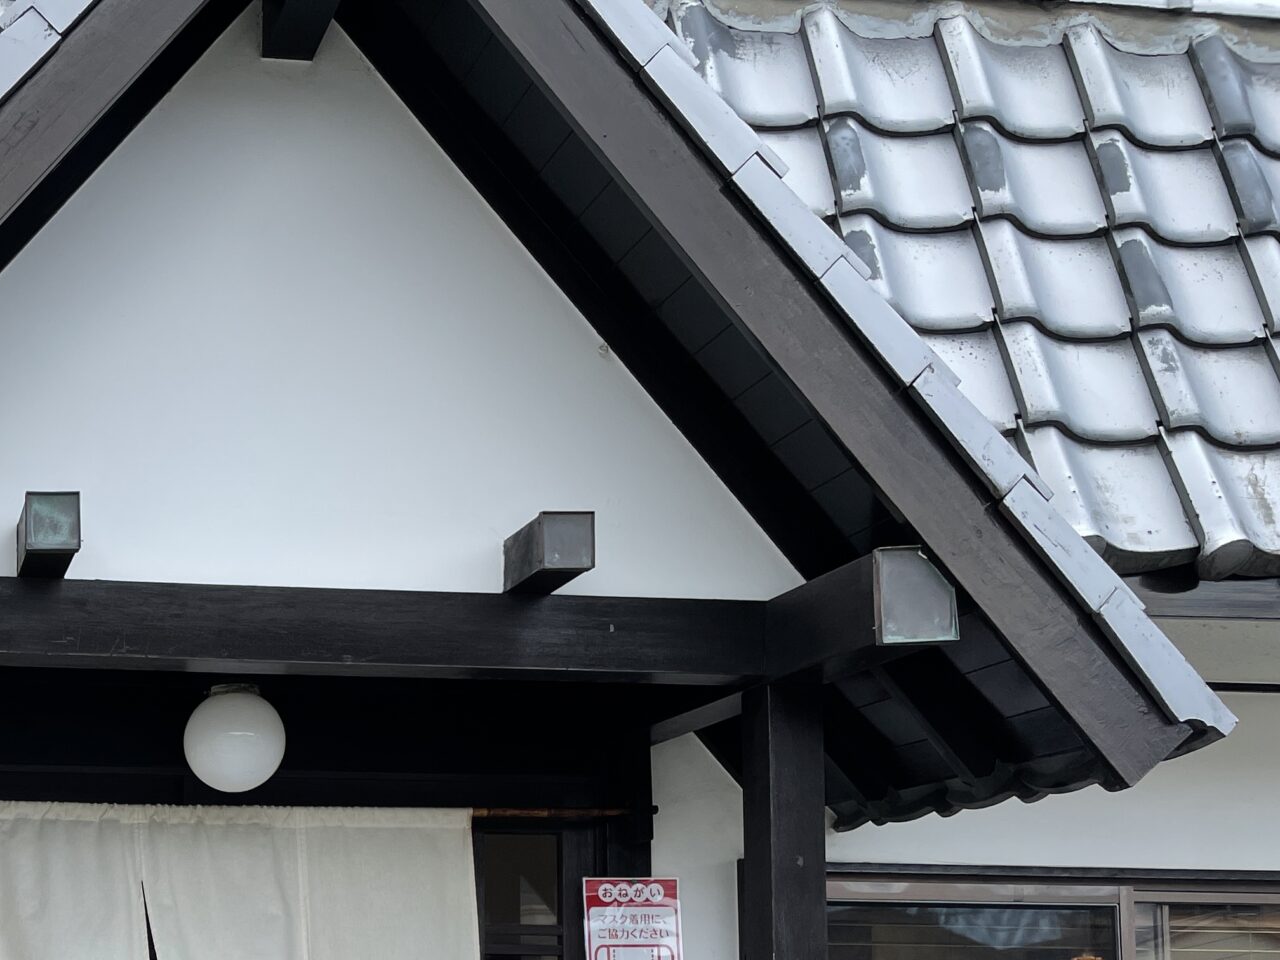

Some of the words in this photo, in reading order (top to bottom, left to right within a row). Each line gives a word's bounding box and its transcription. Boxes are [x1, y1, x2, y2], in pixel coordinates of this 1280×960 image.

[601, 887, 661, 899] おねがい
[598, 928, 670, 940] ご協力ください
